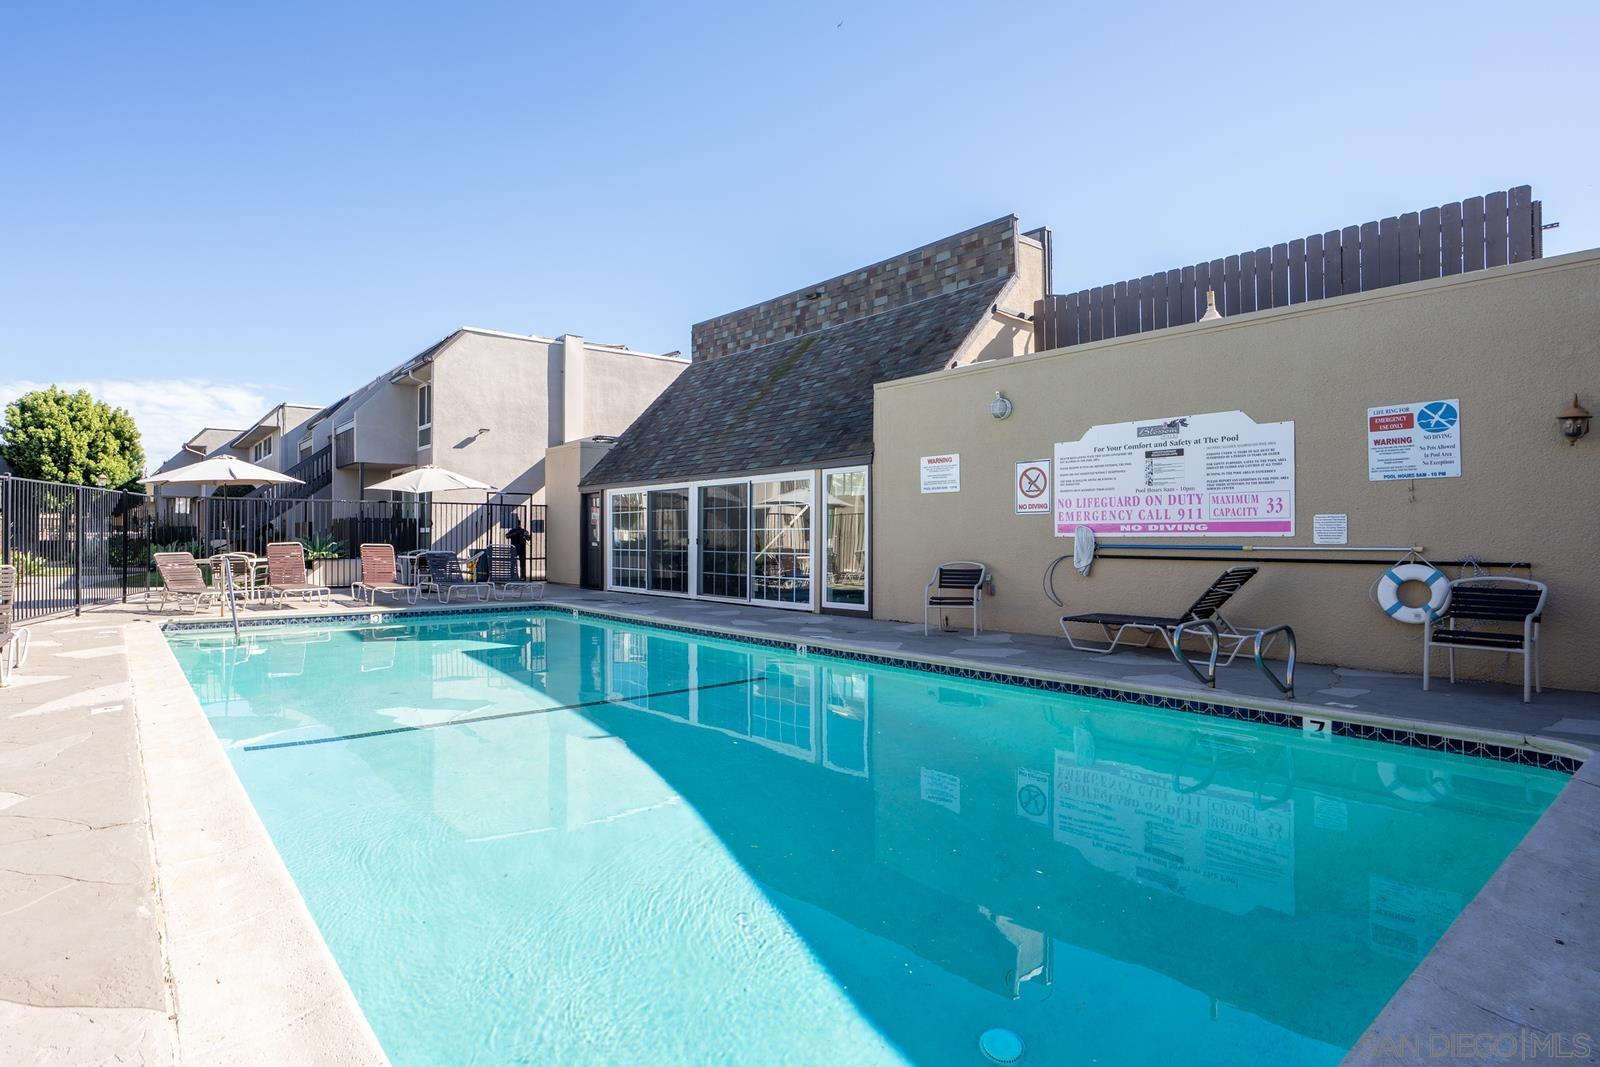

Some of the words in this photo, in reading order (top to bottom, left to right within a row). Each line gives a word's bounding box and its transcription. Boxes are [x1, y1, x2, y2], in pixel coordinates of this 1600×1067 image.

[1374, 415, 1408, 423] EMERGENCY
[1373, 436, 1413, 446] WARNING
[1057, 498, 1072, 509] NO
[1076, 495, 1140, 508] LIFEGUARD
[1146, 495, 1163, 506] ON
[1168, 493, 1204, 505] DUTY
[1212, 494, 1259, 504] MAXIMUM
[1266, 497, 1283, 514] 33
[1058, 510, 1133, 521] EMERGENCY
[1138, 508, 1171, 520] CALL
[1178, 508, 1203, 520] 911
[1213, 507, 1258, 517] CAPACITY
[1310, 720, 1325, 732] 7
